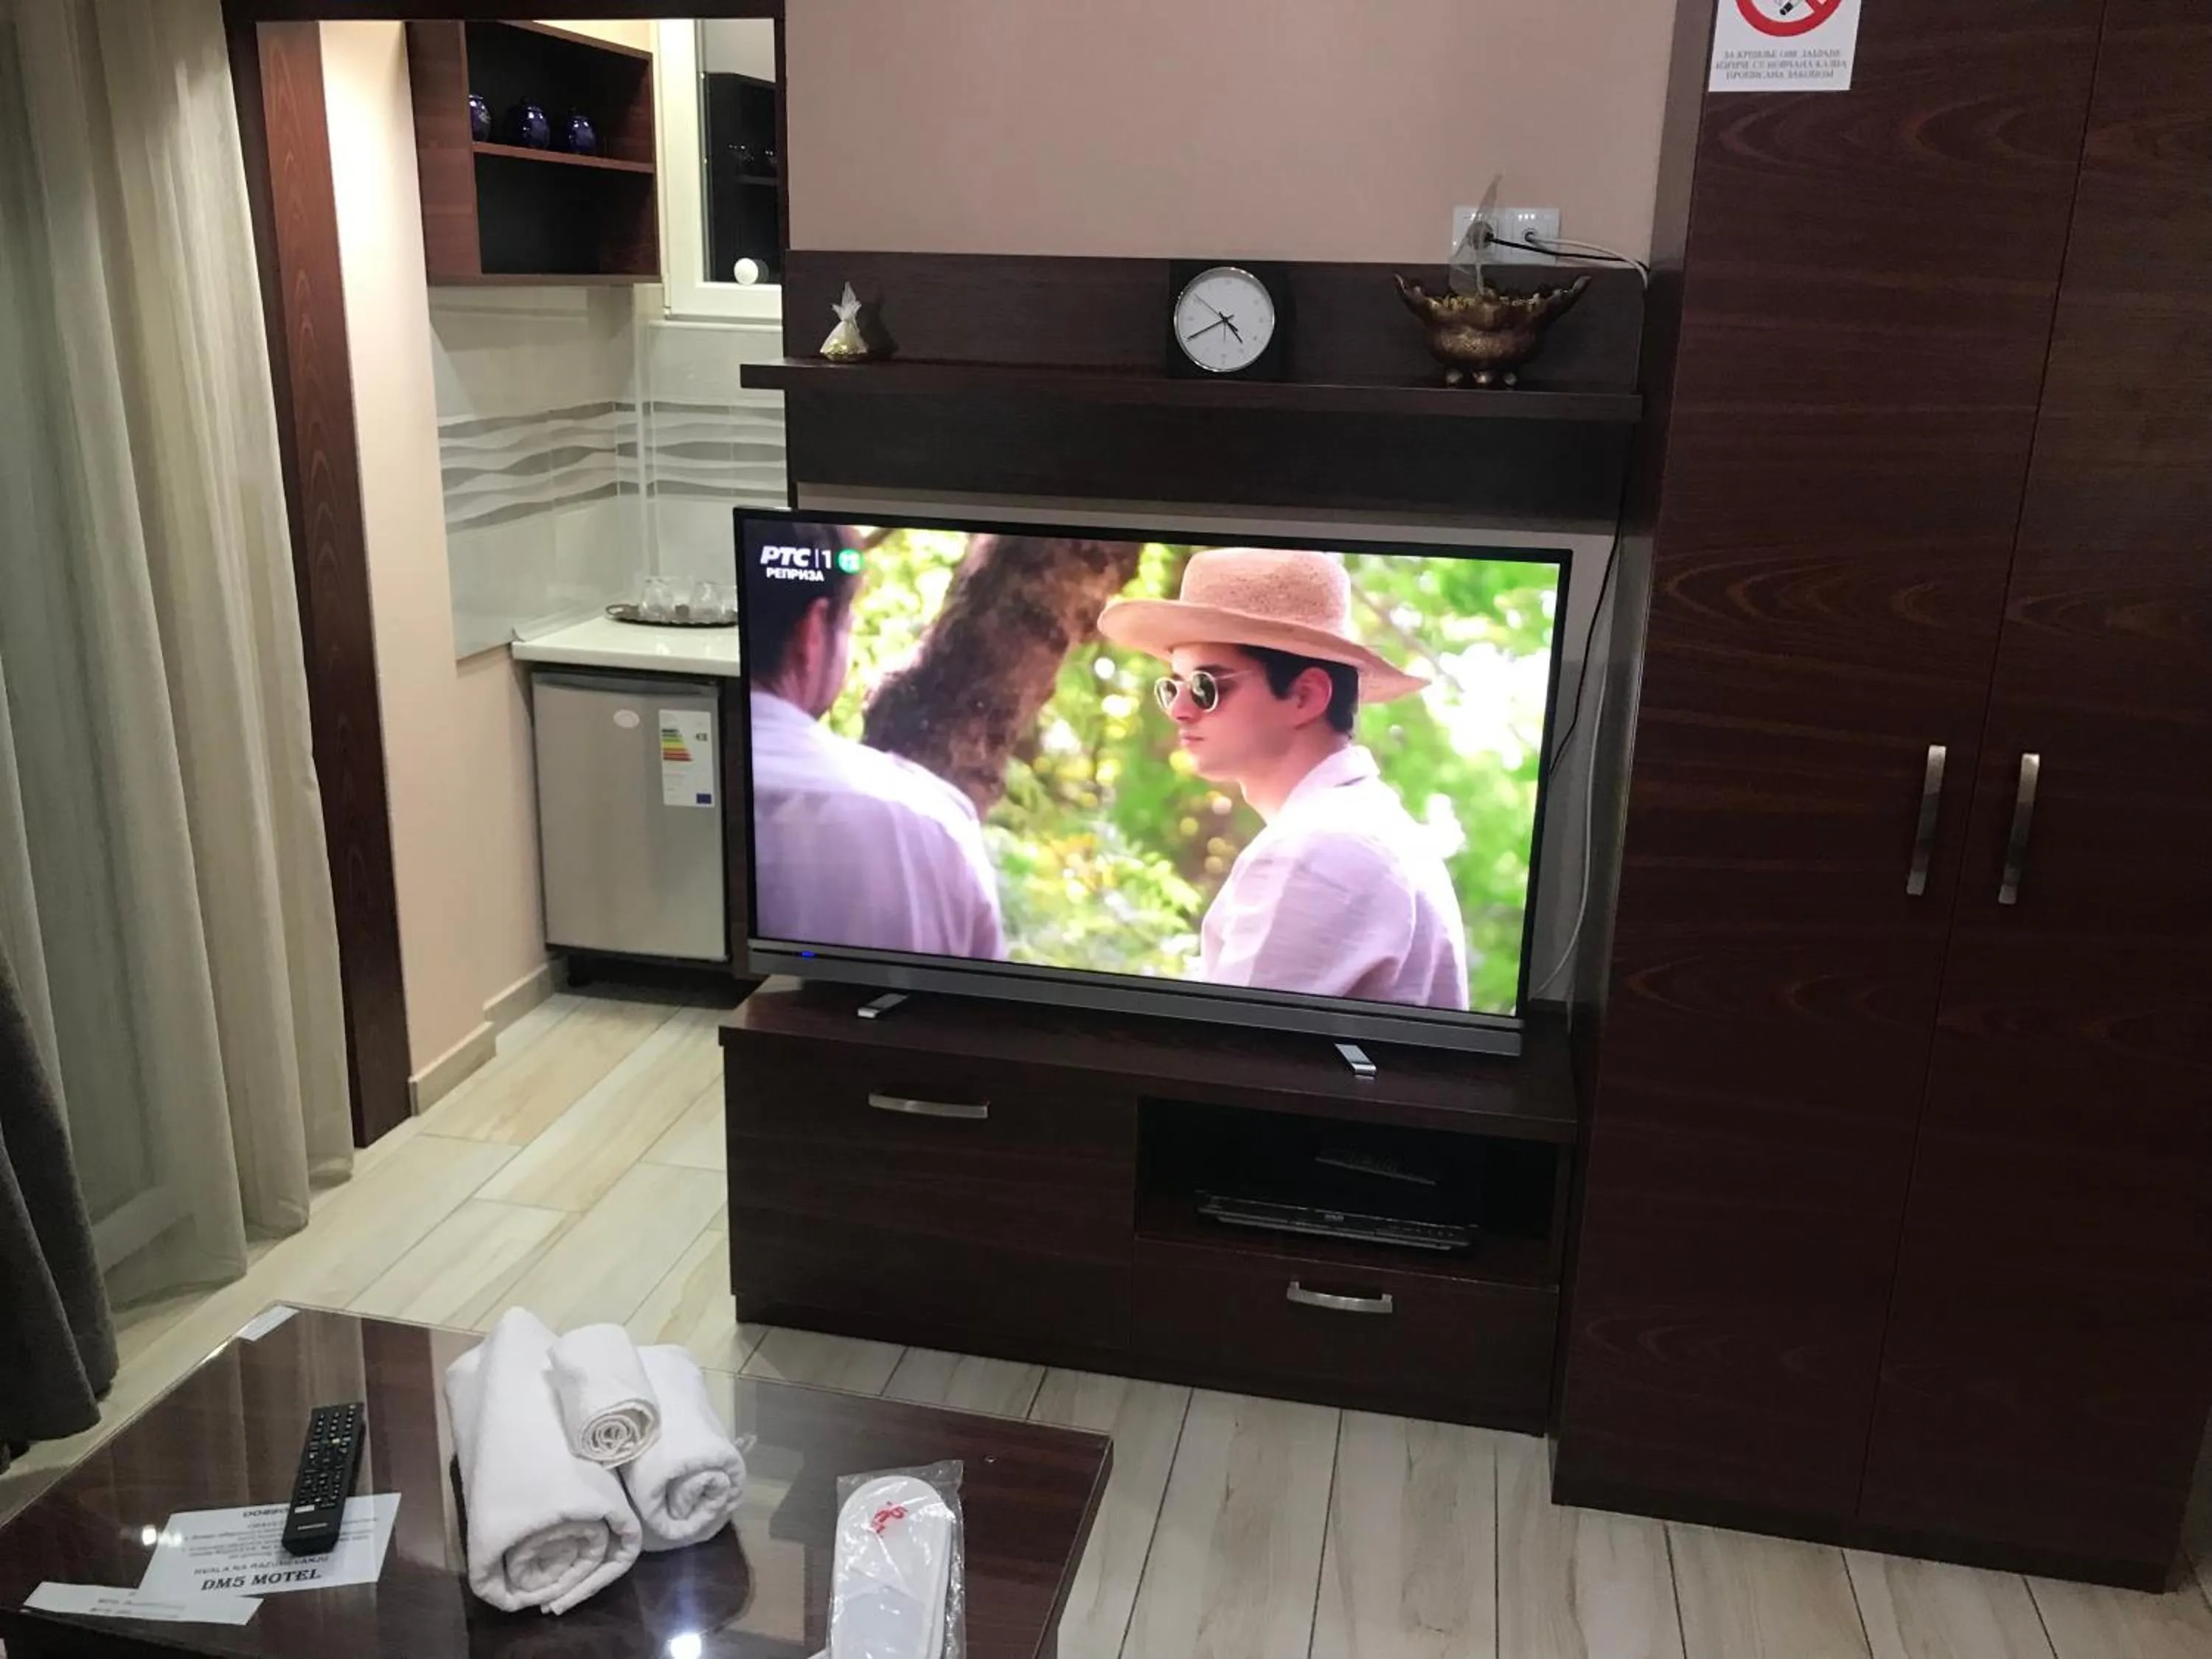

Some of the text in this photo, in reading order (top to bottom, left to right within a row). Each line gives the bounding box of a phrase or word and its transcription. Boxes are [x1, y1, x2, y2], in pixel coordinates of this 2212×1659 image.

[765, 567, 824, 582] РЕПРИЗА
[201, 1568, 322, 1591] DM5 MOTEL
